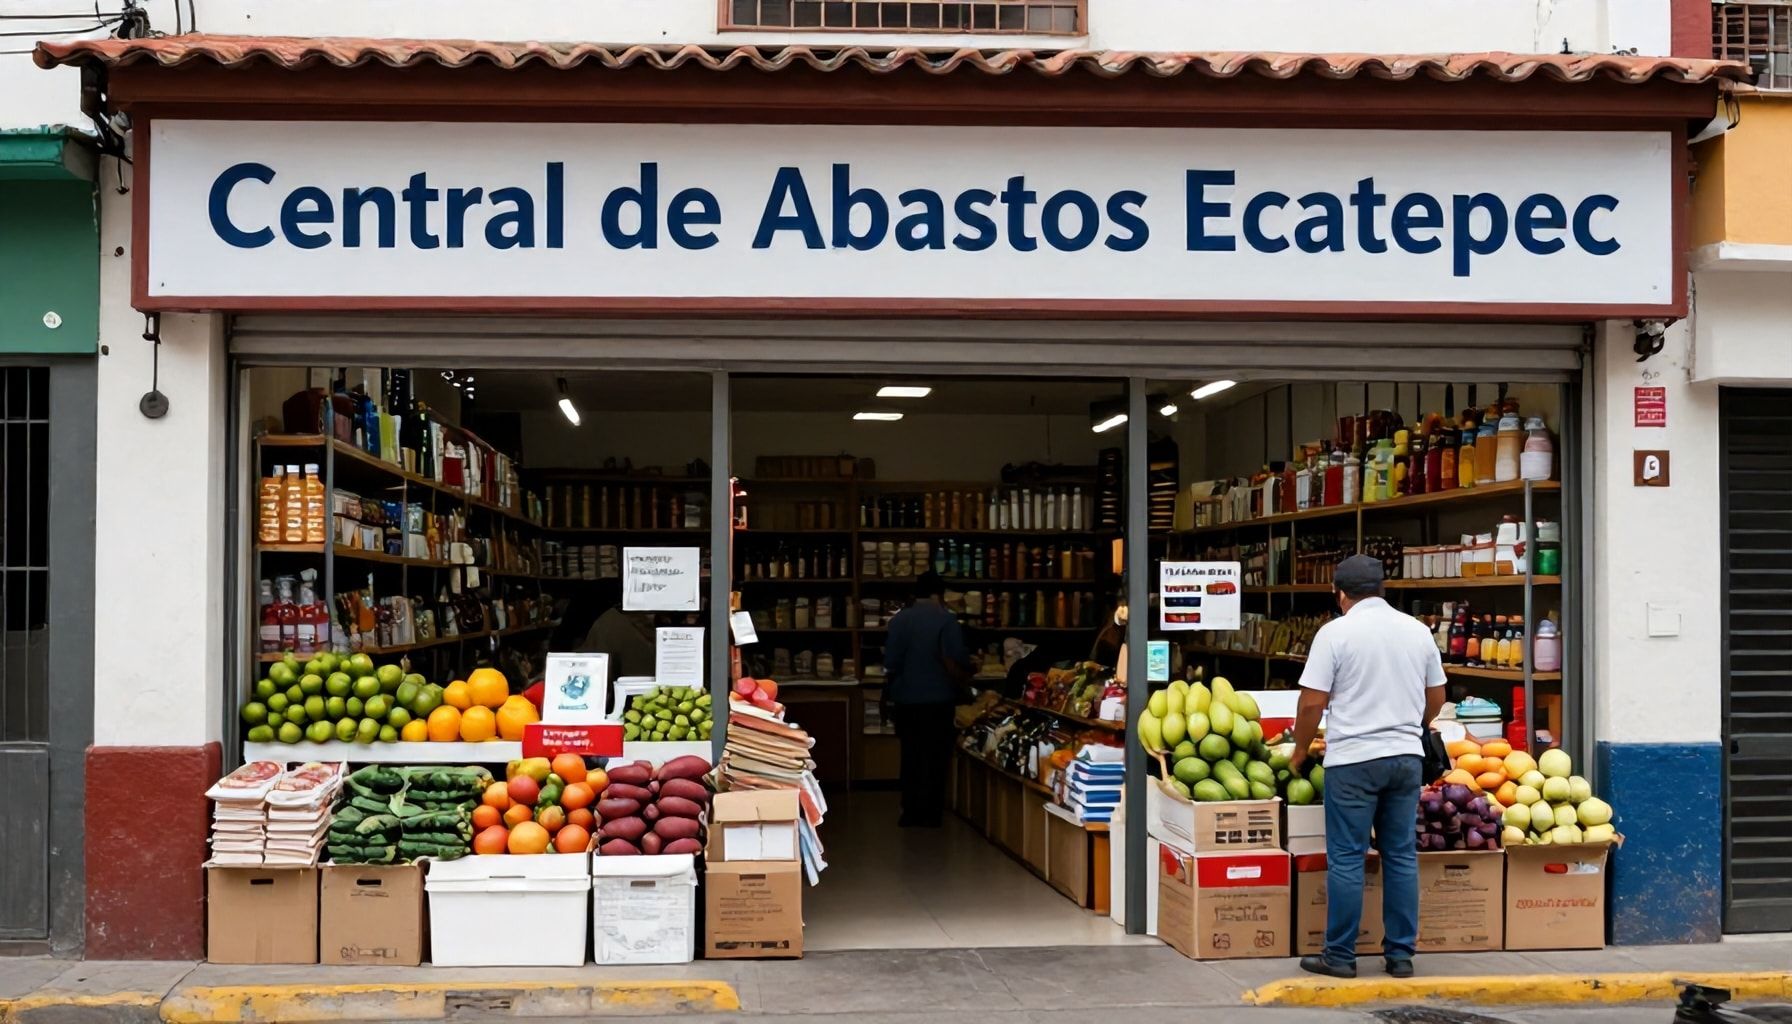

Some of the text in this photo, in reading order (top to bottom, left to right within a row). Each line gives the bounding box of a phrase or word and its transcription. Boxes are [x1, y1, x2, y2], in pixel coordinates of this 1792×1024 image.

[209, 162, 1621, 277] Central de Abastos Ecatepec
